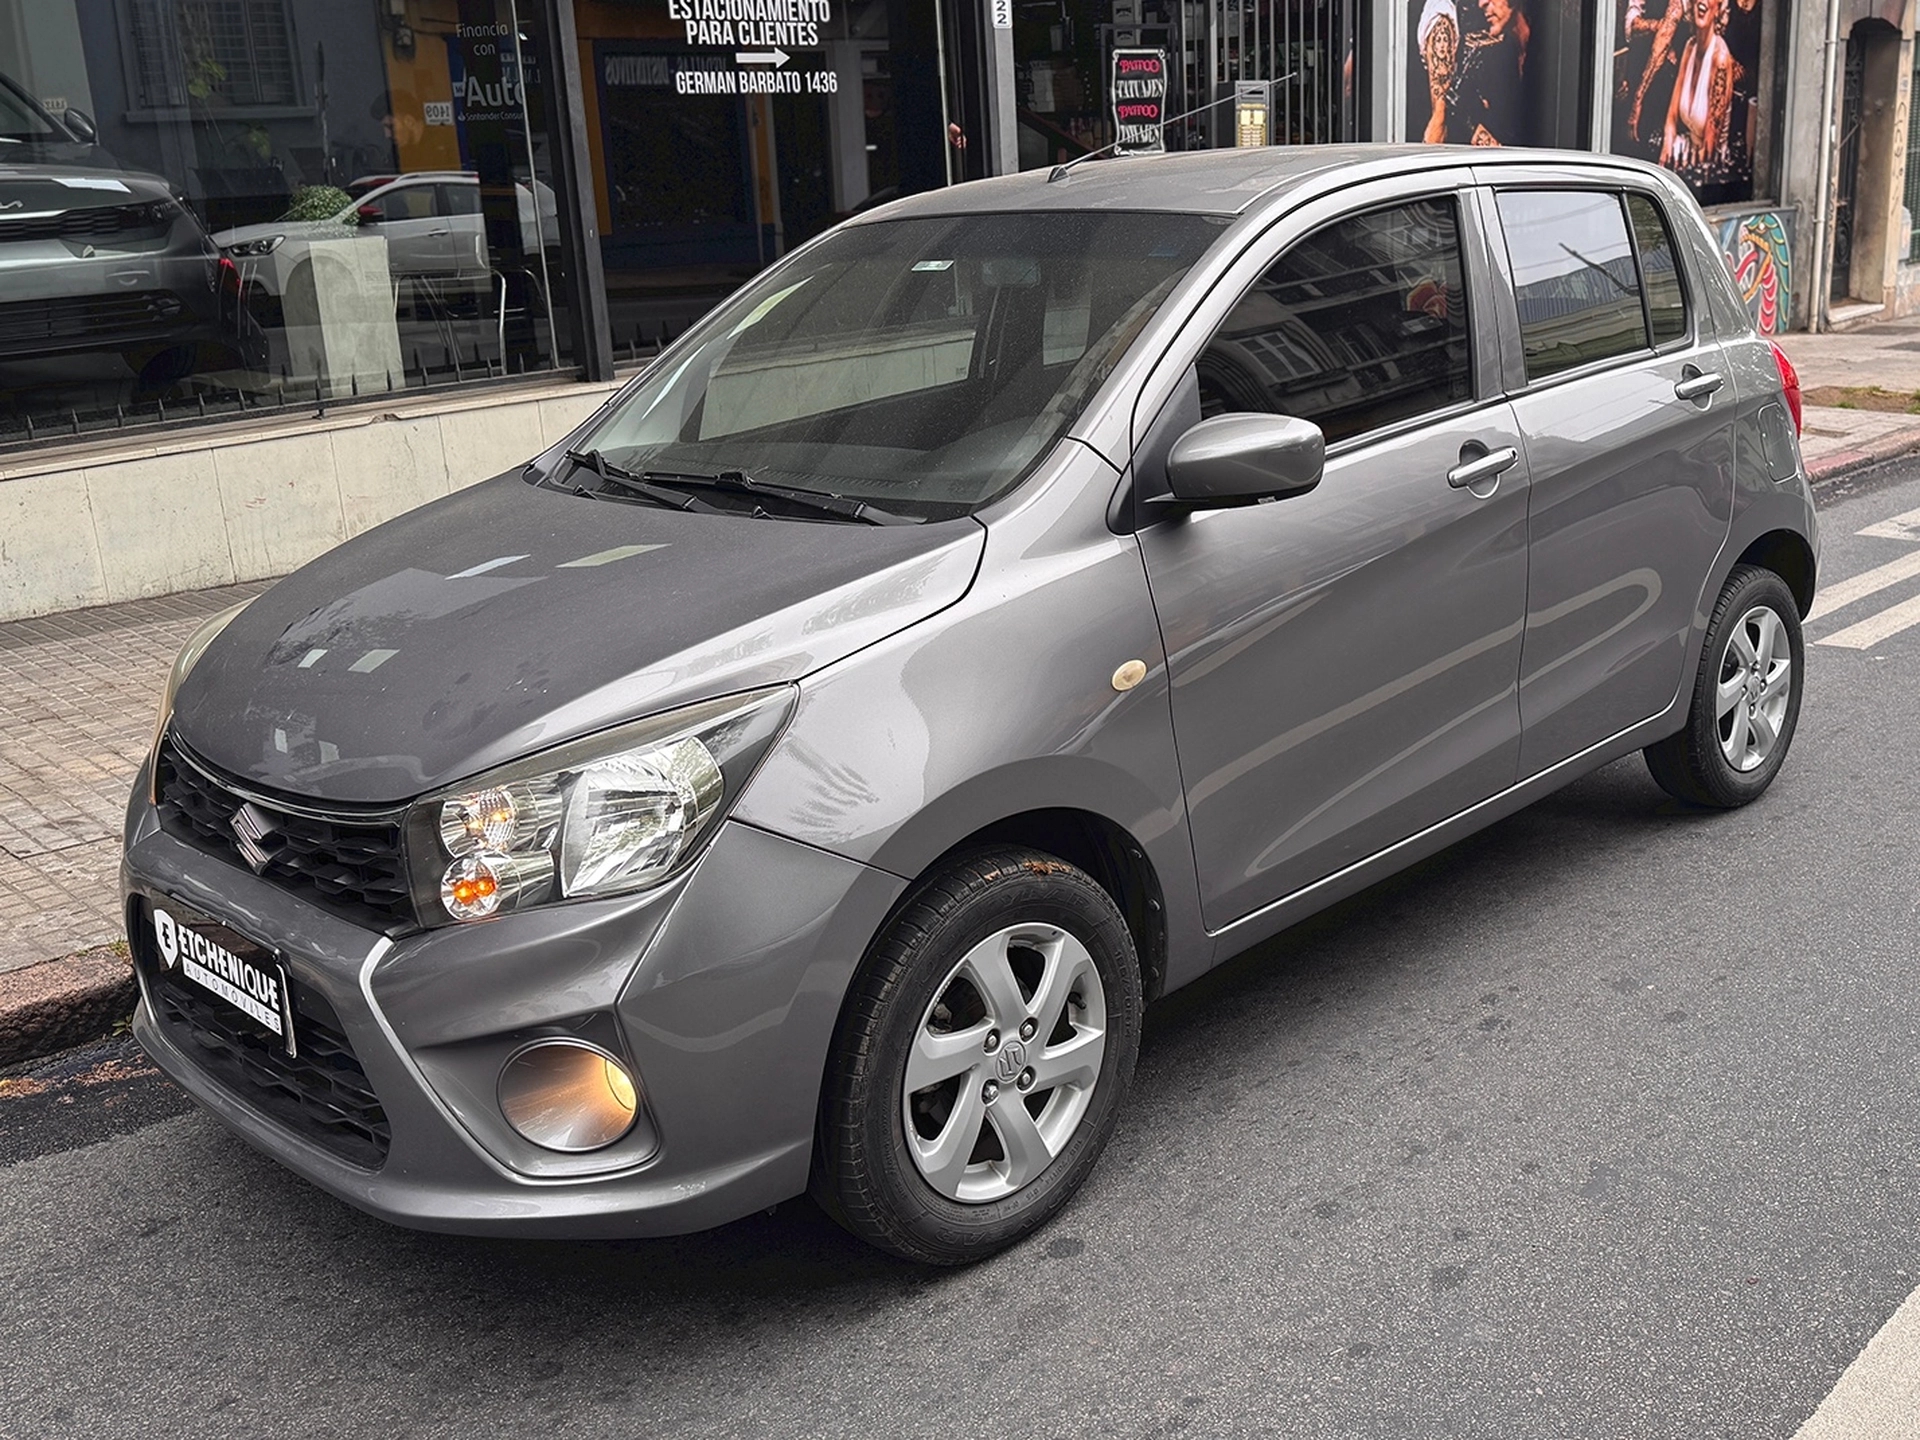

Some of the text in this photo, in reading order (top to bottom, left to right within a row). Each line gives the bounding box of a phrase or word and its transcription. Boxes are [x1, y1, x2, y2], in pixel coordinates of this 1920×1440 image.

[669, 0, 831, 22] ESTACIONAMIENTO
[455, 21, 509, 38] Financia
[686, 20, 819, 46] PARA CLIENTES
[473, 43, 496, 56] con
[1119, 59, 1161, 73] TATTOO
[675, 71, 838, 94] GERMAN BARBATO 1436
[465, 112, 499, 121] Santander
[177, 923, 280, 1012] ETCHENIQUE
[186, 964, 281, 1031] AUTOMOVILES
